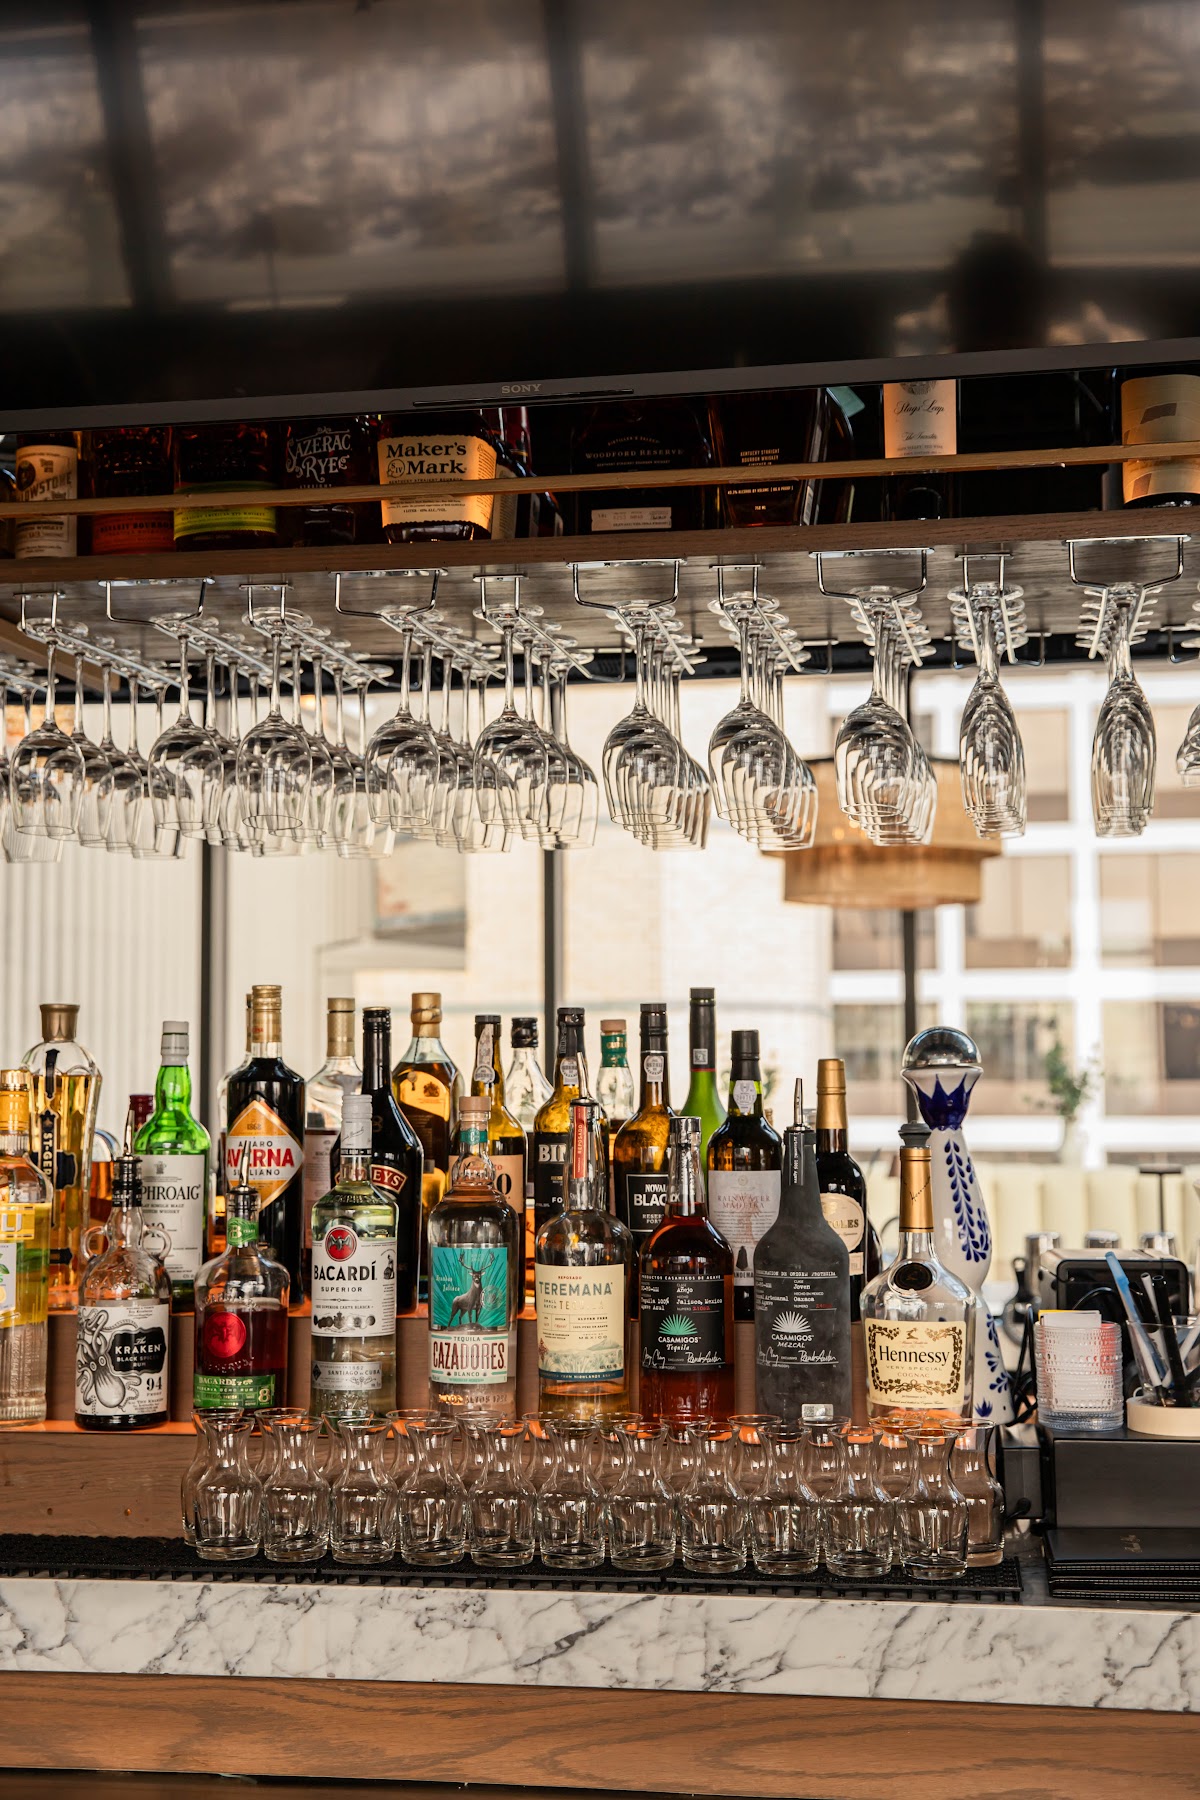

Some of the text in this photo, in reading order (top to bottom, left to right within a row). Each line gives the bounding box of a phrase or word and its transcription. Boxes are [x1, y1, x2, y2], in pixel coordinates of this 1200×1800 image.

[501, 383, 542, 394] SONY
[285, 433, 352, 474] SAZERAC
[386, 441, 468, 459] Maker's
[584, 448, 684, 460] WOODFORD RESERVE
[406, 459, 466, 476] Mark
[238, 1140, 273, 1148] AARO
[313, 1260, 377, 1282] BACARDÍ
[538, 1281, 613, 1297] TEREMANA
[676, 1286, 694, 1295] Añejo
[453, 1335, 481, 1343] TEQUILA
[657, 1336, 699, 1344] CASAMIGOS
[771, 1333, 812, 1342] CASAMIGOS
[114, 1343, 161, 1355] KRAKEN
[666, 1343, 690, 1352] Tequila
[777, 1341, 805, 1349] MEZCAL
[116, 1355, 138, 1363] BLACK
[432, 1340, 505, 1371] CAZADORES
[879, 1344, 950, 1367] Hennessy
[896, 1371, 930, 1379] COGNAC
[146, 1376, 163, 1392] 94
[258, 1387, 271, 1403] 8
